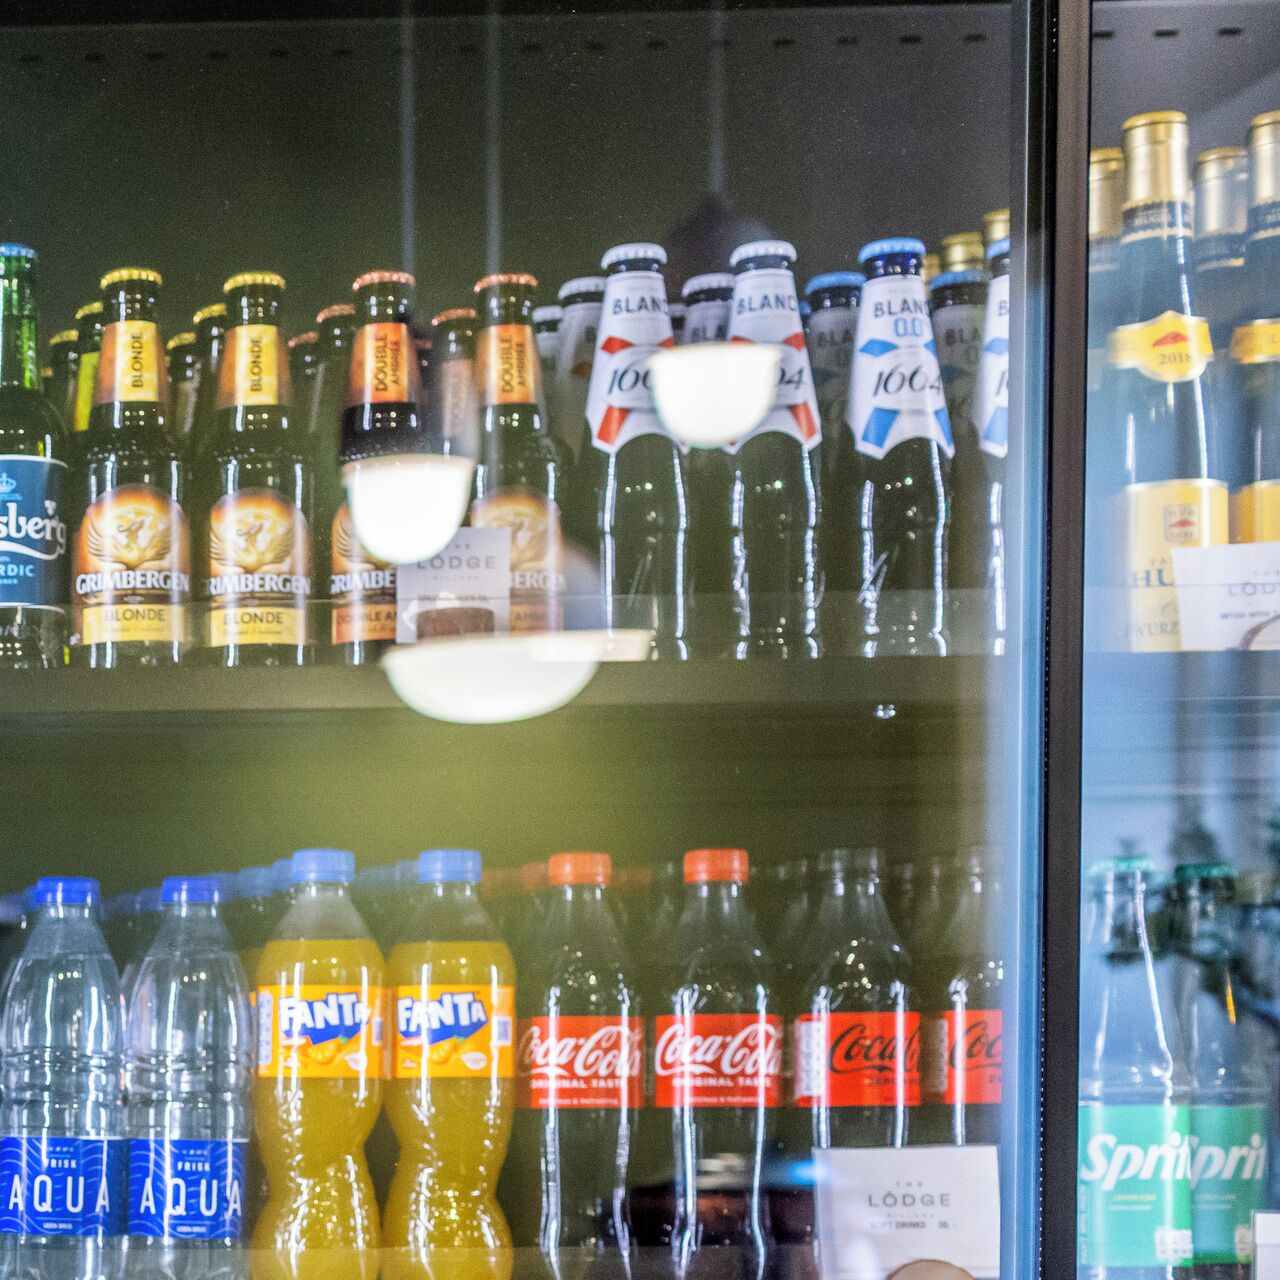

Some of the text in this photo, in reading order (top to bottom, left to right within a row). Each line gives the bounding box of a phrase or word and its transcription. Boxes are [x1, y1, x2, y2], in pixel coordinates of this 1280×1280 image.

[132, 333, 144, 388] BLONDE
[250, 337, 263, 393] BLONDE
[376, 334, 388, 393] DOUBLE
[76, 570, 189, 595] GRIMBERGEN
[223, 611, 285, 625] BLONDE
[279, 993, 372, 1034] FANTA
[397, 993, 488, 1032] FANTA
[44, 1159, 77, 1169] FRISK
[178, 1161, 211, 1172] FRISK
[9, 1174, 110, 1213] AQUA
[140, 1177, 241, 1217] AQUA
